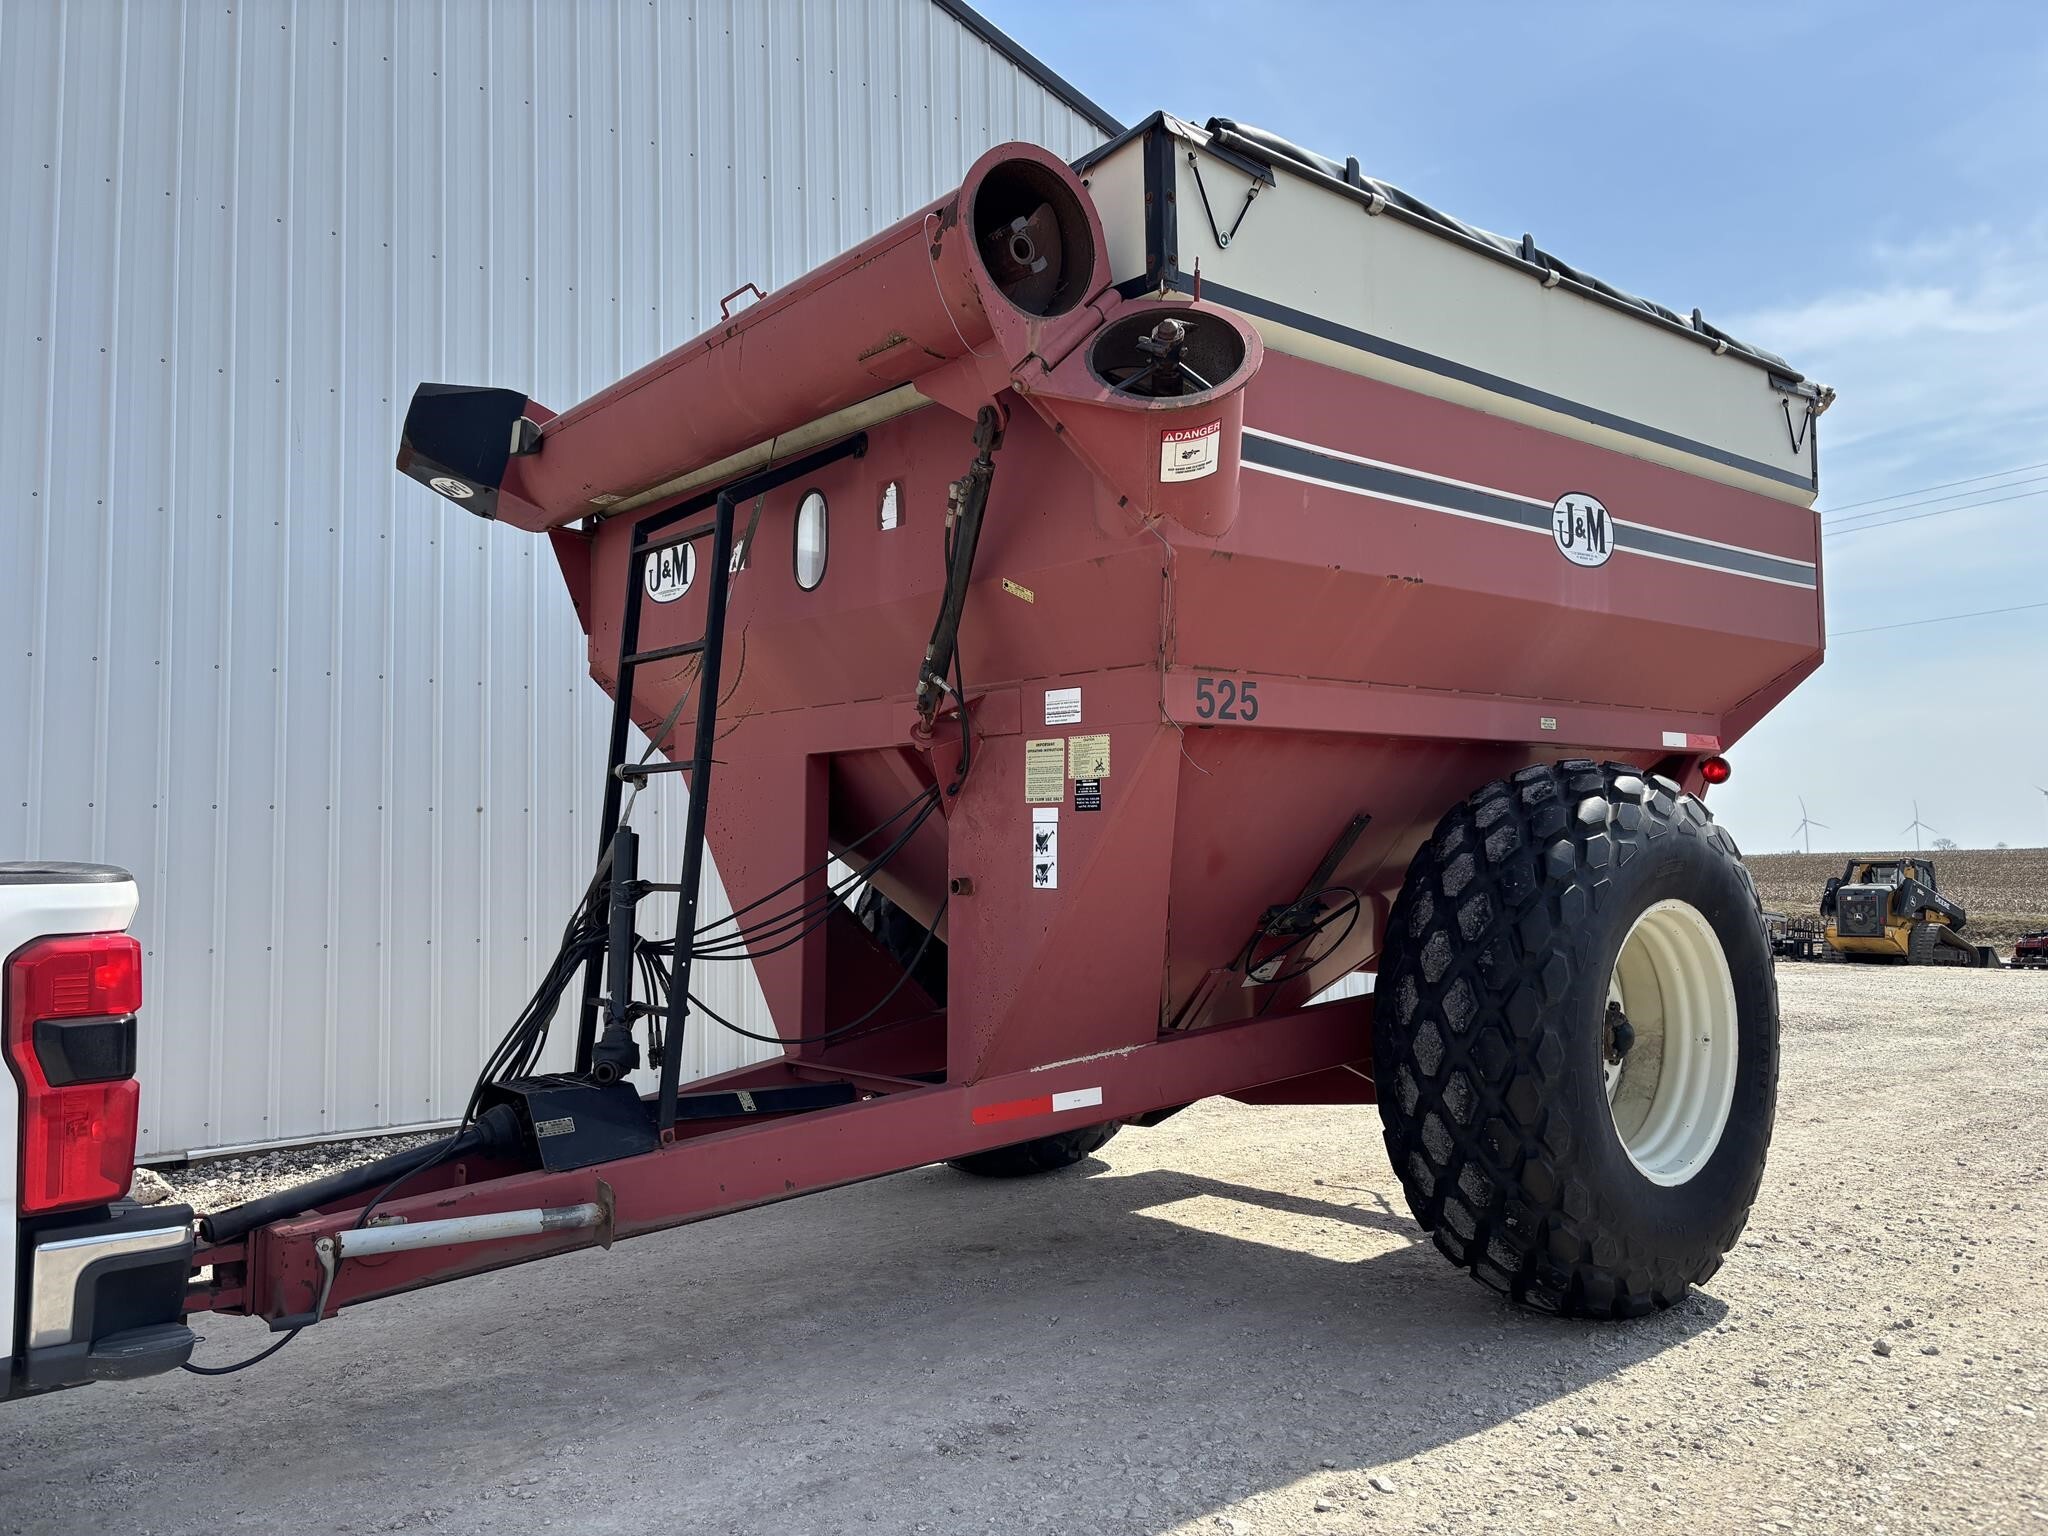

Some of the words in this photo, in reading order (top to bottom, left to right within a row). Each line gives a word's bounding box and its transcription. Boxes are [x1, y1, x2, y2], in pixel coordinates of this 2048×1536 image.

[1175, 421, 1220, 441] DANGER
[1557, 502, 1607, 554] J&M
[648, 543, 689, 592] J&M
[1196, 677, 1259, 721] 525
